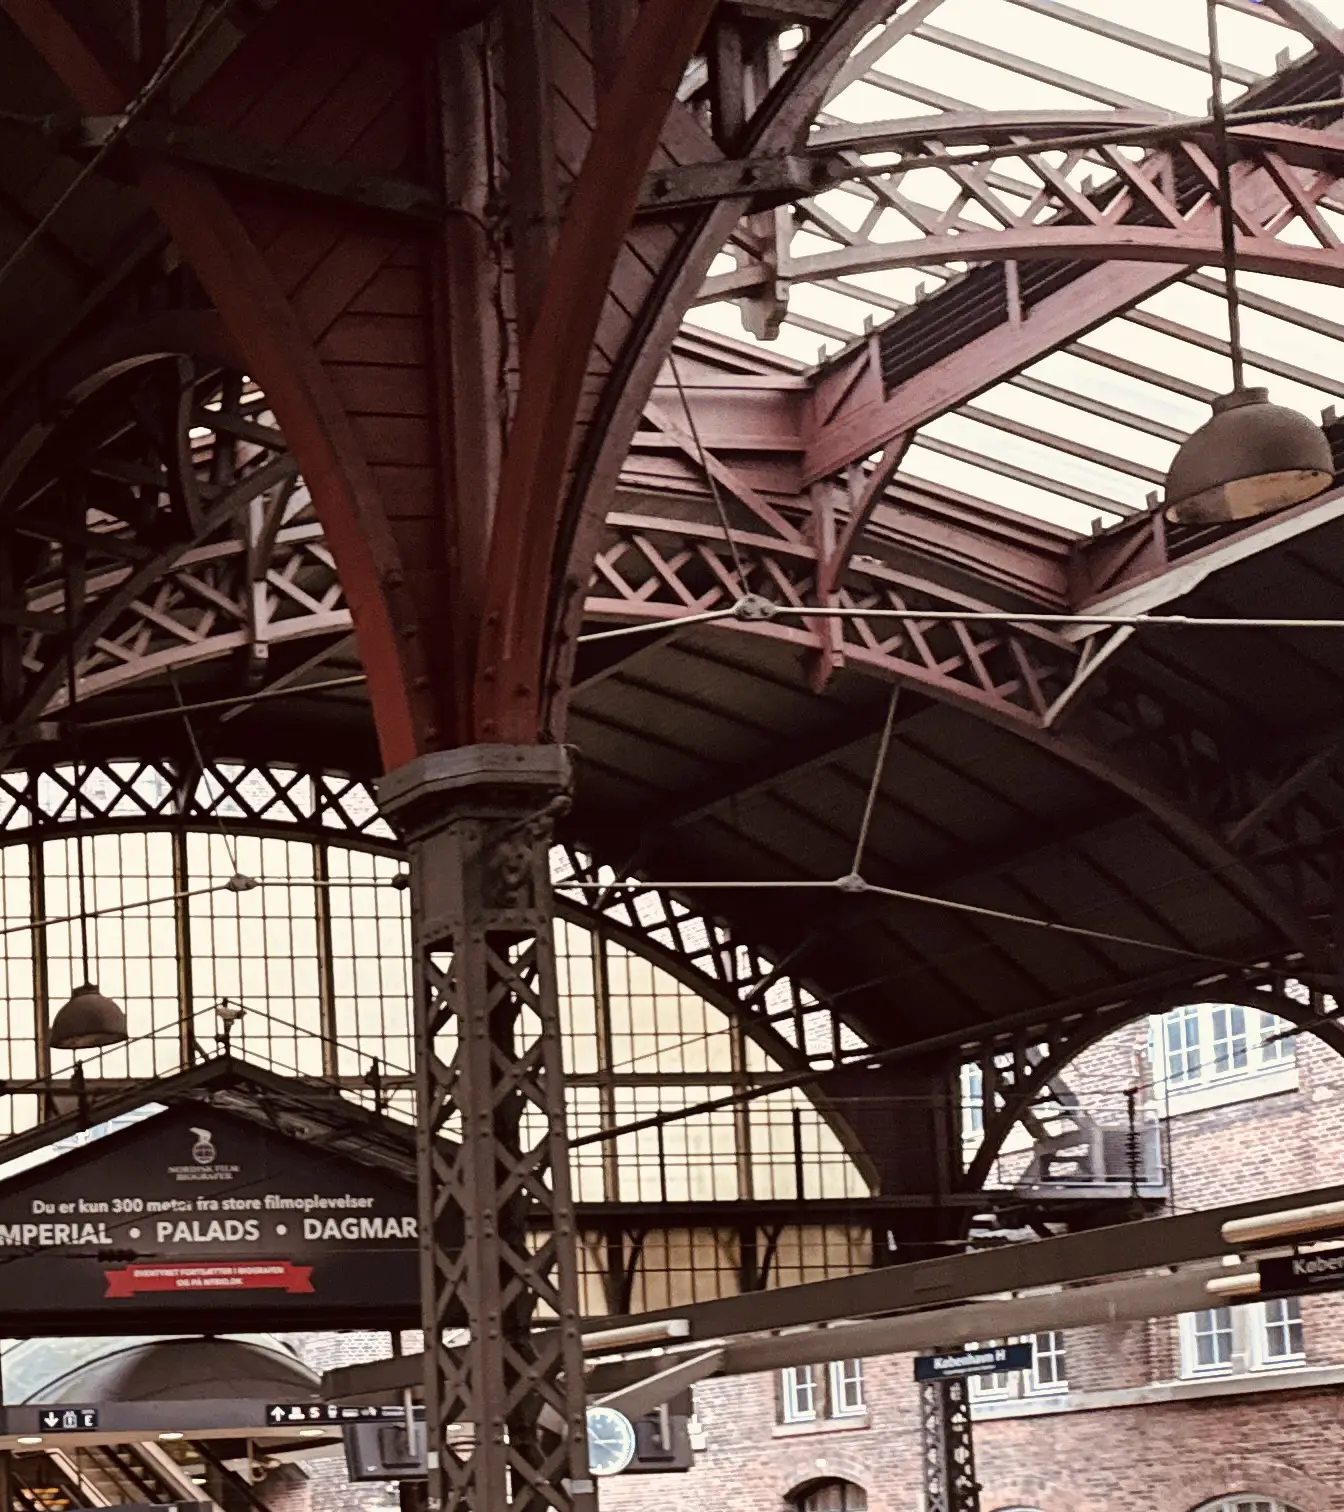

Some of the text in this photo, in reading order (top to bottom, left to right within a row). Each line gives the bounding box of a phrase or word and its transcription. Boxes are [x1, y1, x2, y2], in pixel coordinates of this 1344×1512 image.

[32, 1200, 56, 1215] Du
[59, 1203, 76, 1214] er
[78, 1199, 109, 1213] kun
[112, 1198, 143, 1212] 300
[196, 1196, 219, 1211] fra
[222, 1197, 262, 1210] store
[264, 1194, 375, 1212] filmoplevelser
[157, 1219, 260, 1243] PALADS
[303, 1216, 419, 1240] DAGMAR
